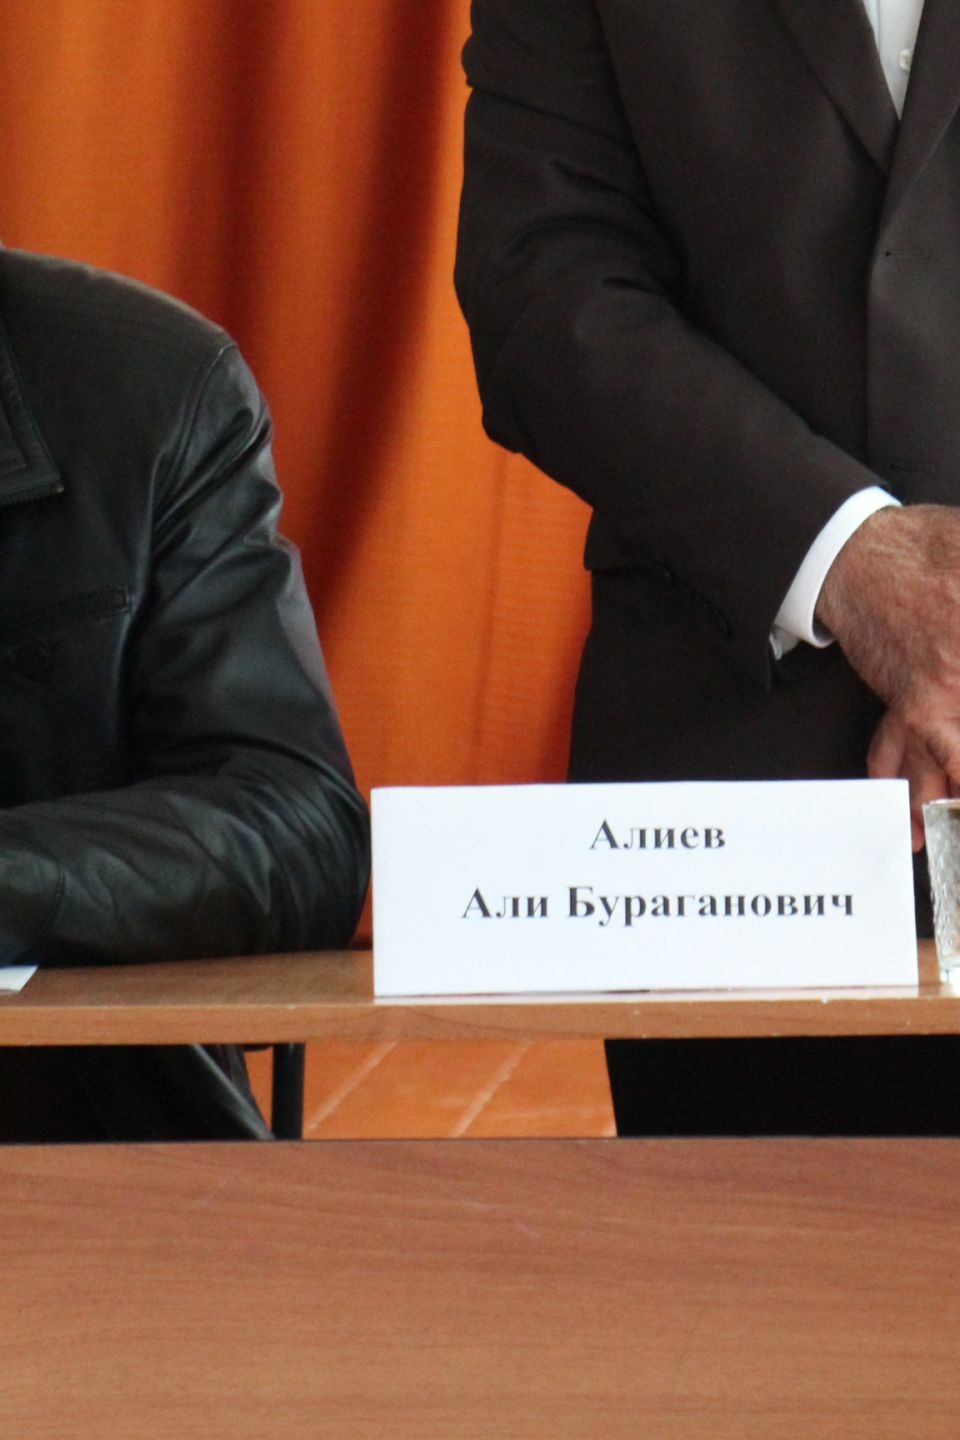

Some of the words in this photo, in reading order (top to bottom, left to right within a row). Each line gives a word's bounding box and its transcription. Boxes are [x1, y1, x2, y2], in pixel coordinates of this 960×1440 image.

[590, 819, 726, 849] Алиев
[461, 887, 549, 918] Али
[568, 886, 854, 927] Бураганович
